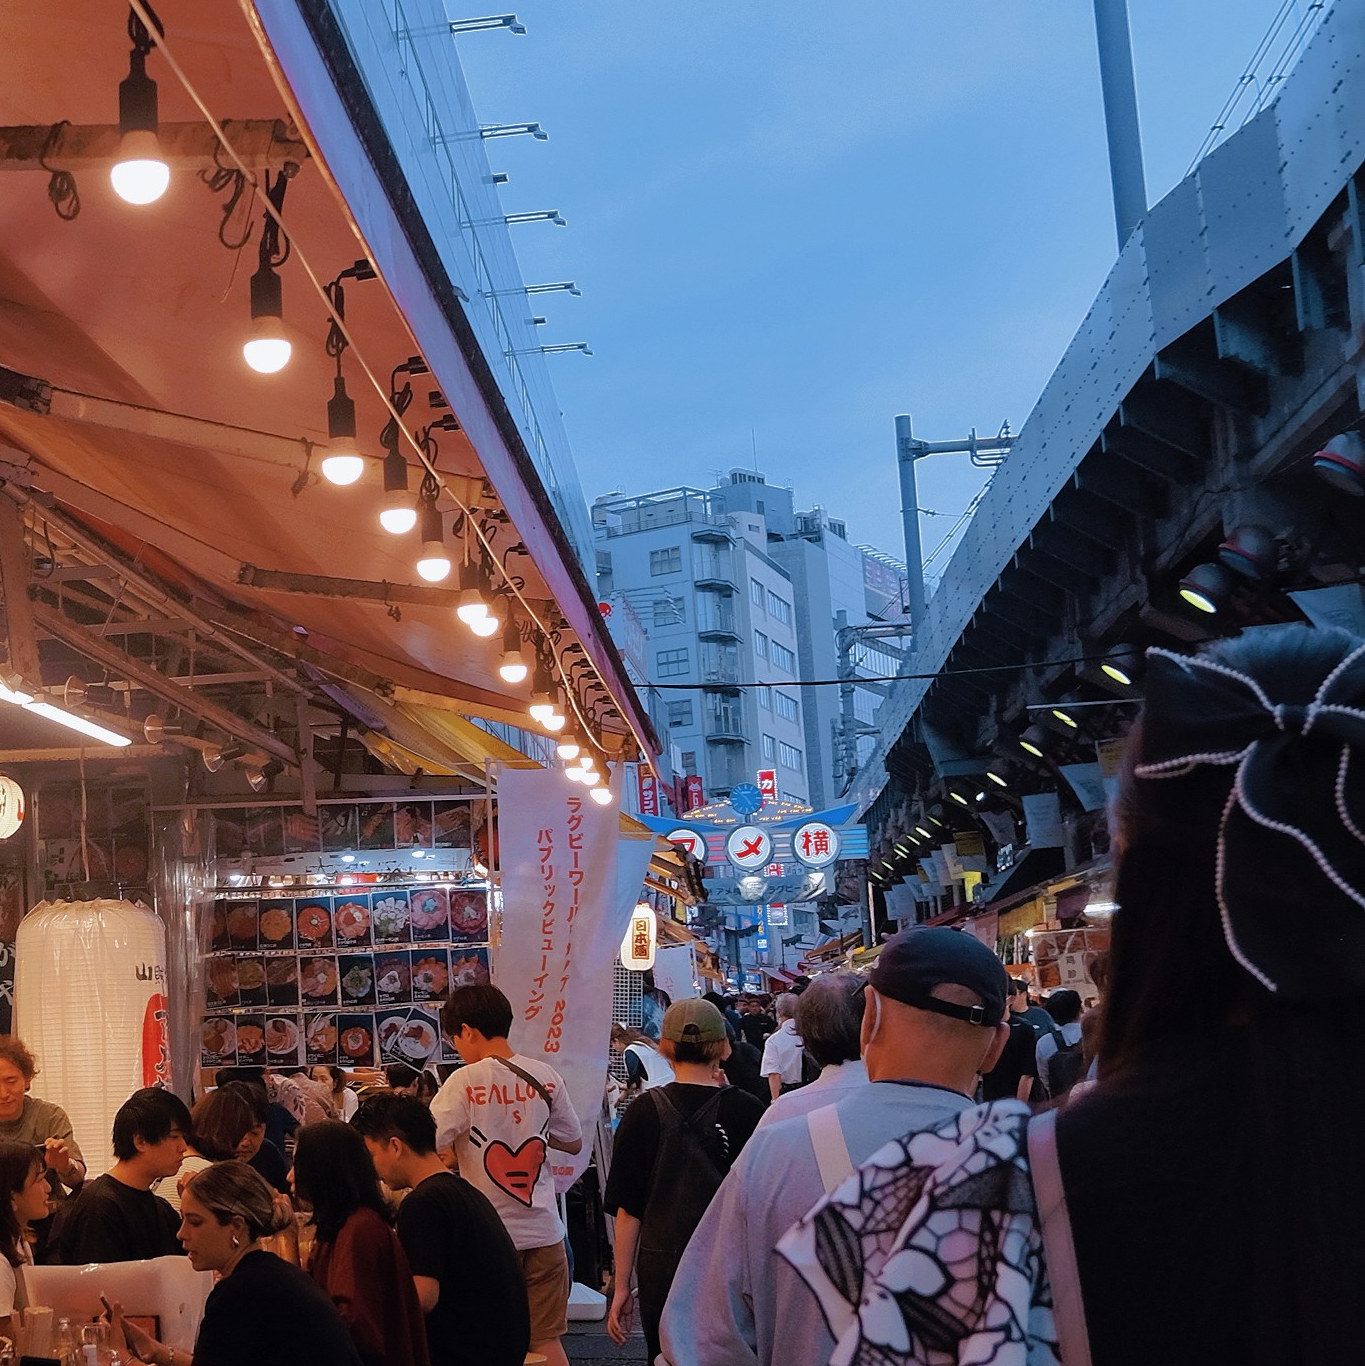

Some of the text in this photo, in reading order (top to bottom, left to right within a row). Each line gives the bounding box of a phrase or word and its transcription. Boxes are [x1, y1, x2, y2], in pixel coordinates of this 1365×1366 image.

[524, 827, 557, 1021] パブリックビューイング
[633, 919, 650, 958] 日本酒
[544, 999, 566, 1053] 2023
[466, 1082, 556, 1106] REALLOE
[512, 1109, 523, 1125] S
